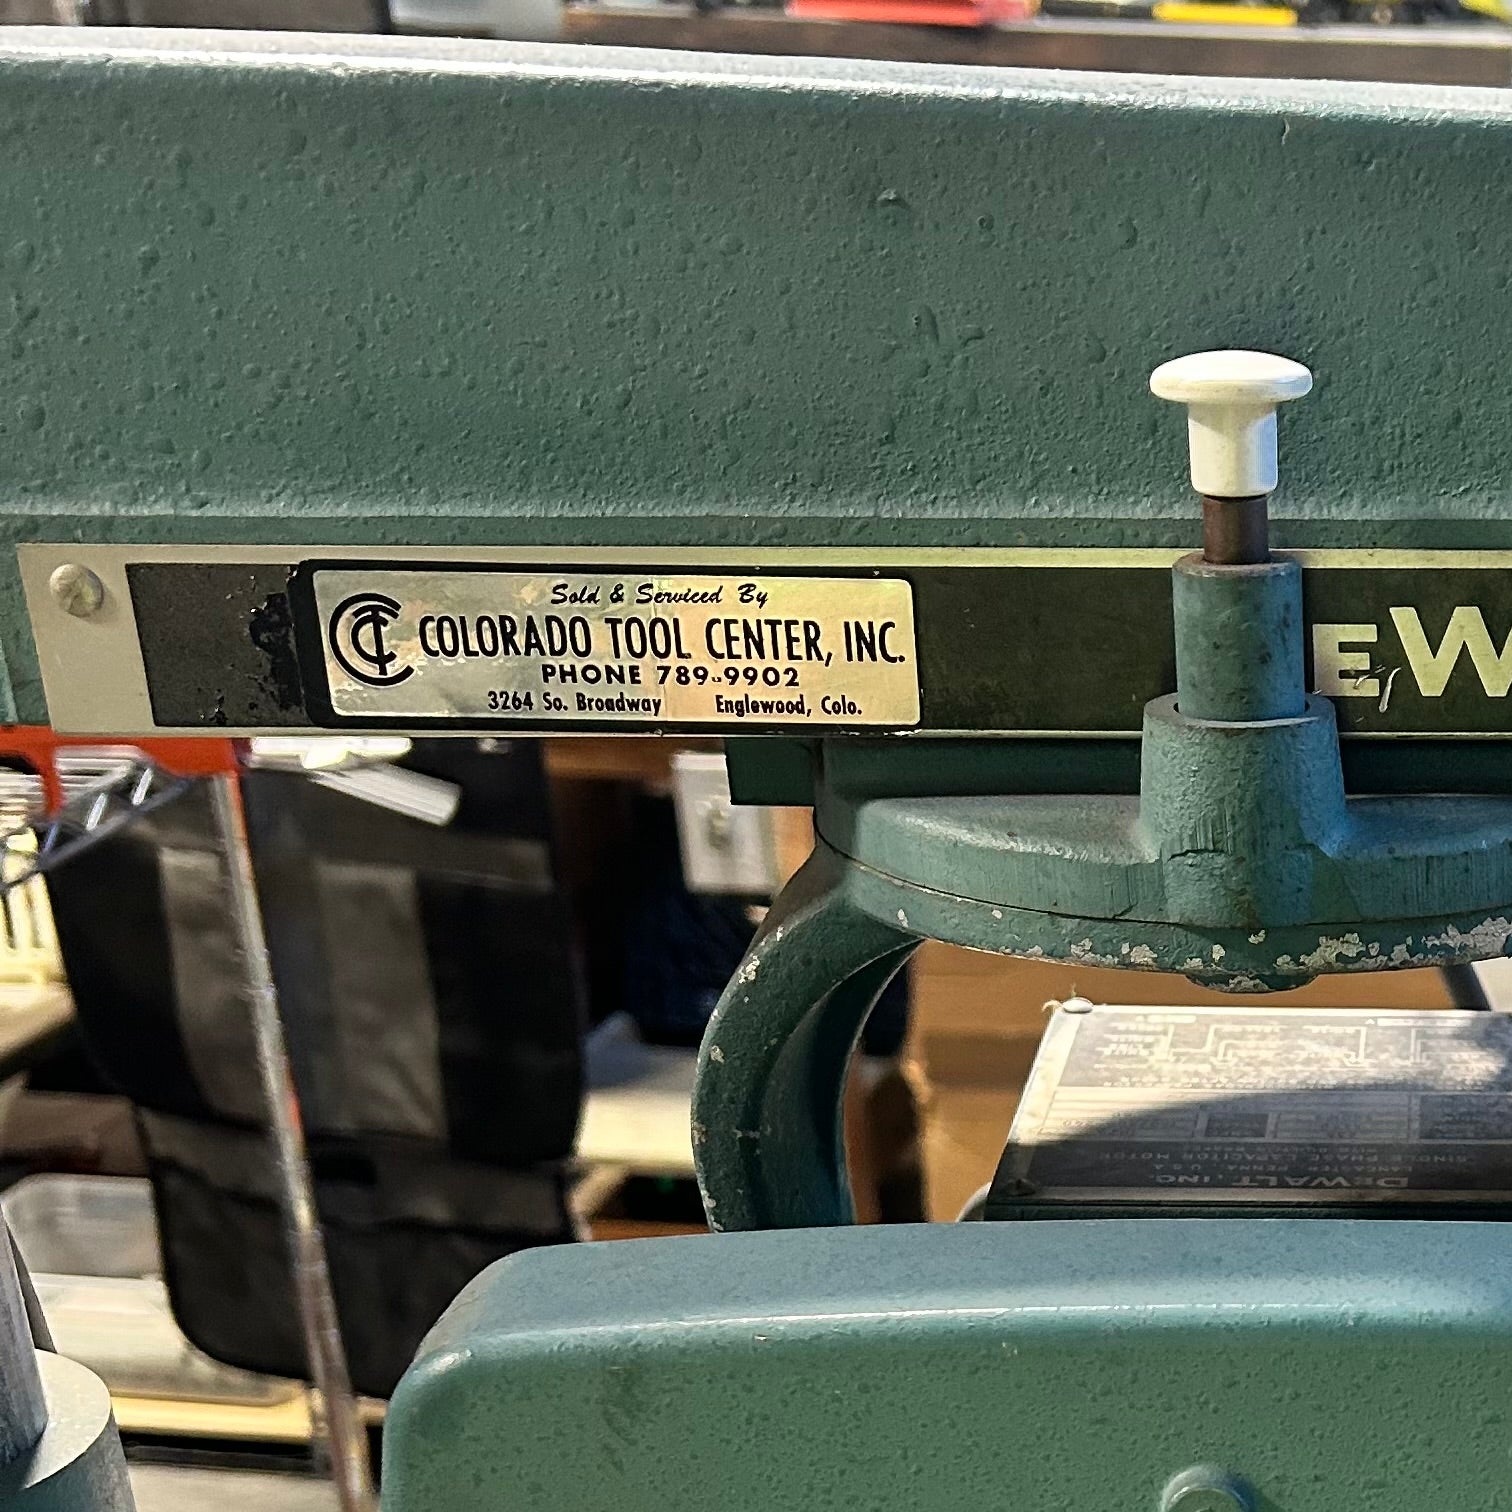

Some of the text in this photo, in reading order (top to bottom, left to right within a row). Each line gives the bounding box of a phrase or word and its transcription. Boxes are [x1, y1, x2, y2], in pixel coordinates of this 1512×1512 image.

[550, 582, 769, 610] Sold & Serviced By
[418, 614, 906, 668] COLORADO TOOL CENTER, INC.
[541, 663, 800, 688] PHONE 789-9902
[487, 690, 863, 719] 3264 So. Broadway Englewood, Colo.
